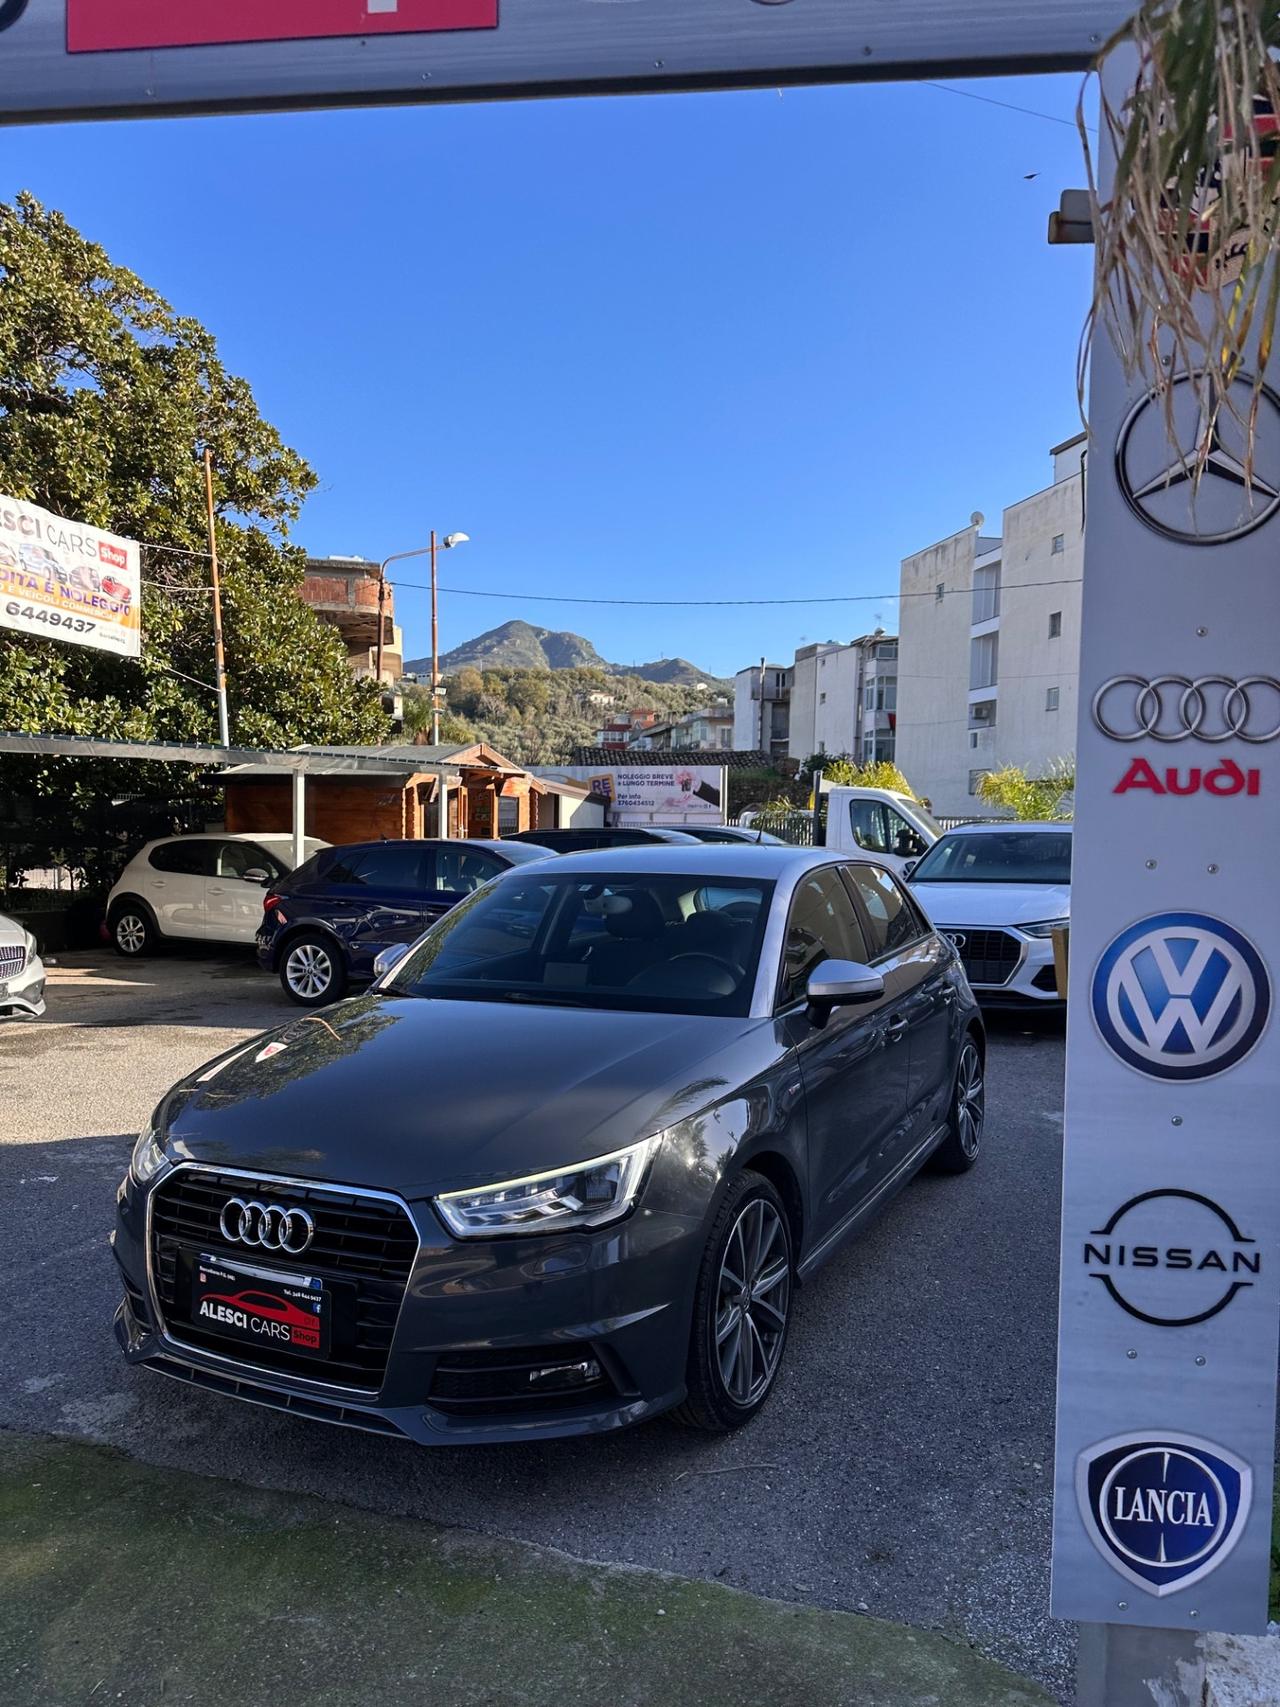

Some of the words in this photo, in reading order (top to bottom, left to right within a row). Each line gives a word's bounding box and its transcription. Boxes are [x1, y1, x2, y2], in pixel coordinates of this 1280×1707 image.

[0, 507, 41, 539] SCI
[47, 524, 98, 558] CARS
[101, 547, 126, 567] Shop
[5, 601, 97, 634] 6449437
[44, 580, 55, 595] E
[60, 586, 131, 617] NOLEGGIO
[1113, 757, 1261, 797] Audi
[1083, 1243, 1261, 1274] NISSAN
[200, 1300, 247, 1329] ALESCI
[250, 1317, 291, 1341] CARS
[1114, 1486, 1214, 1527] LANCIA
